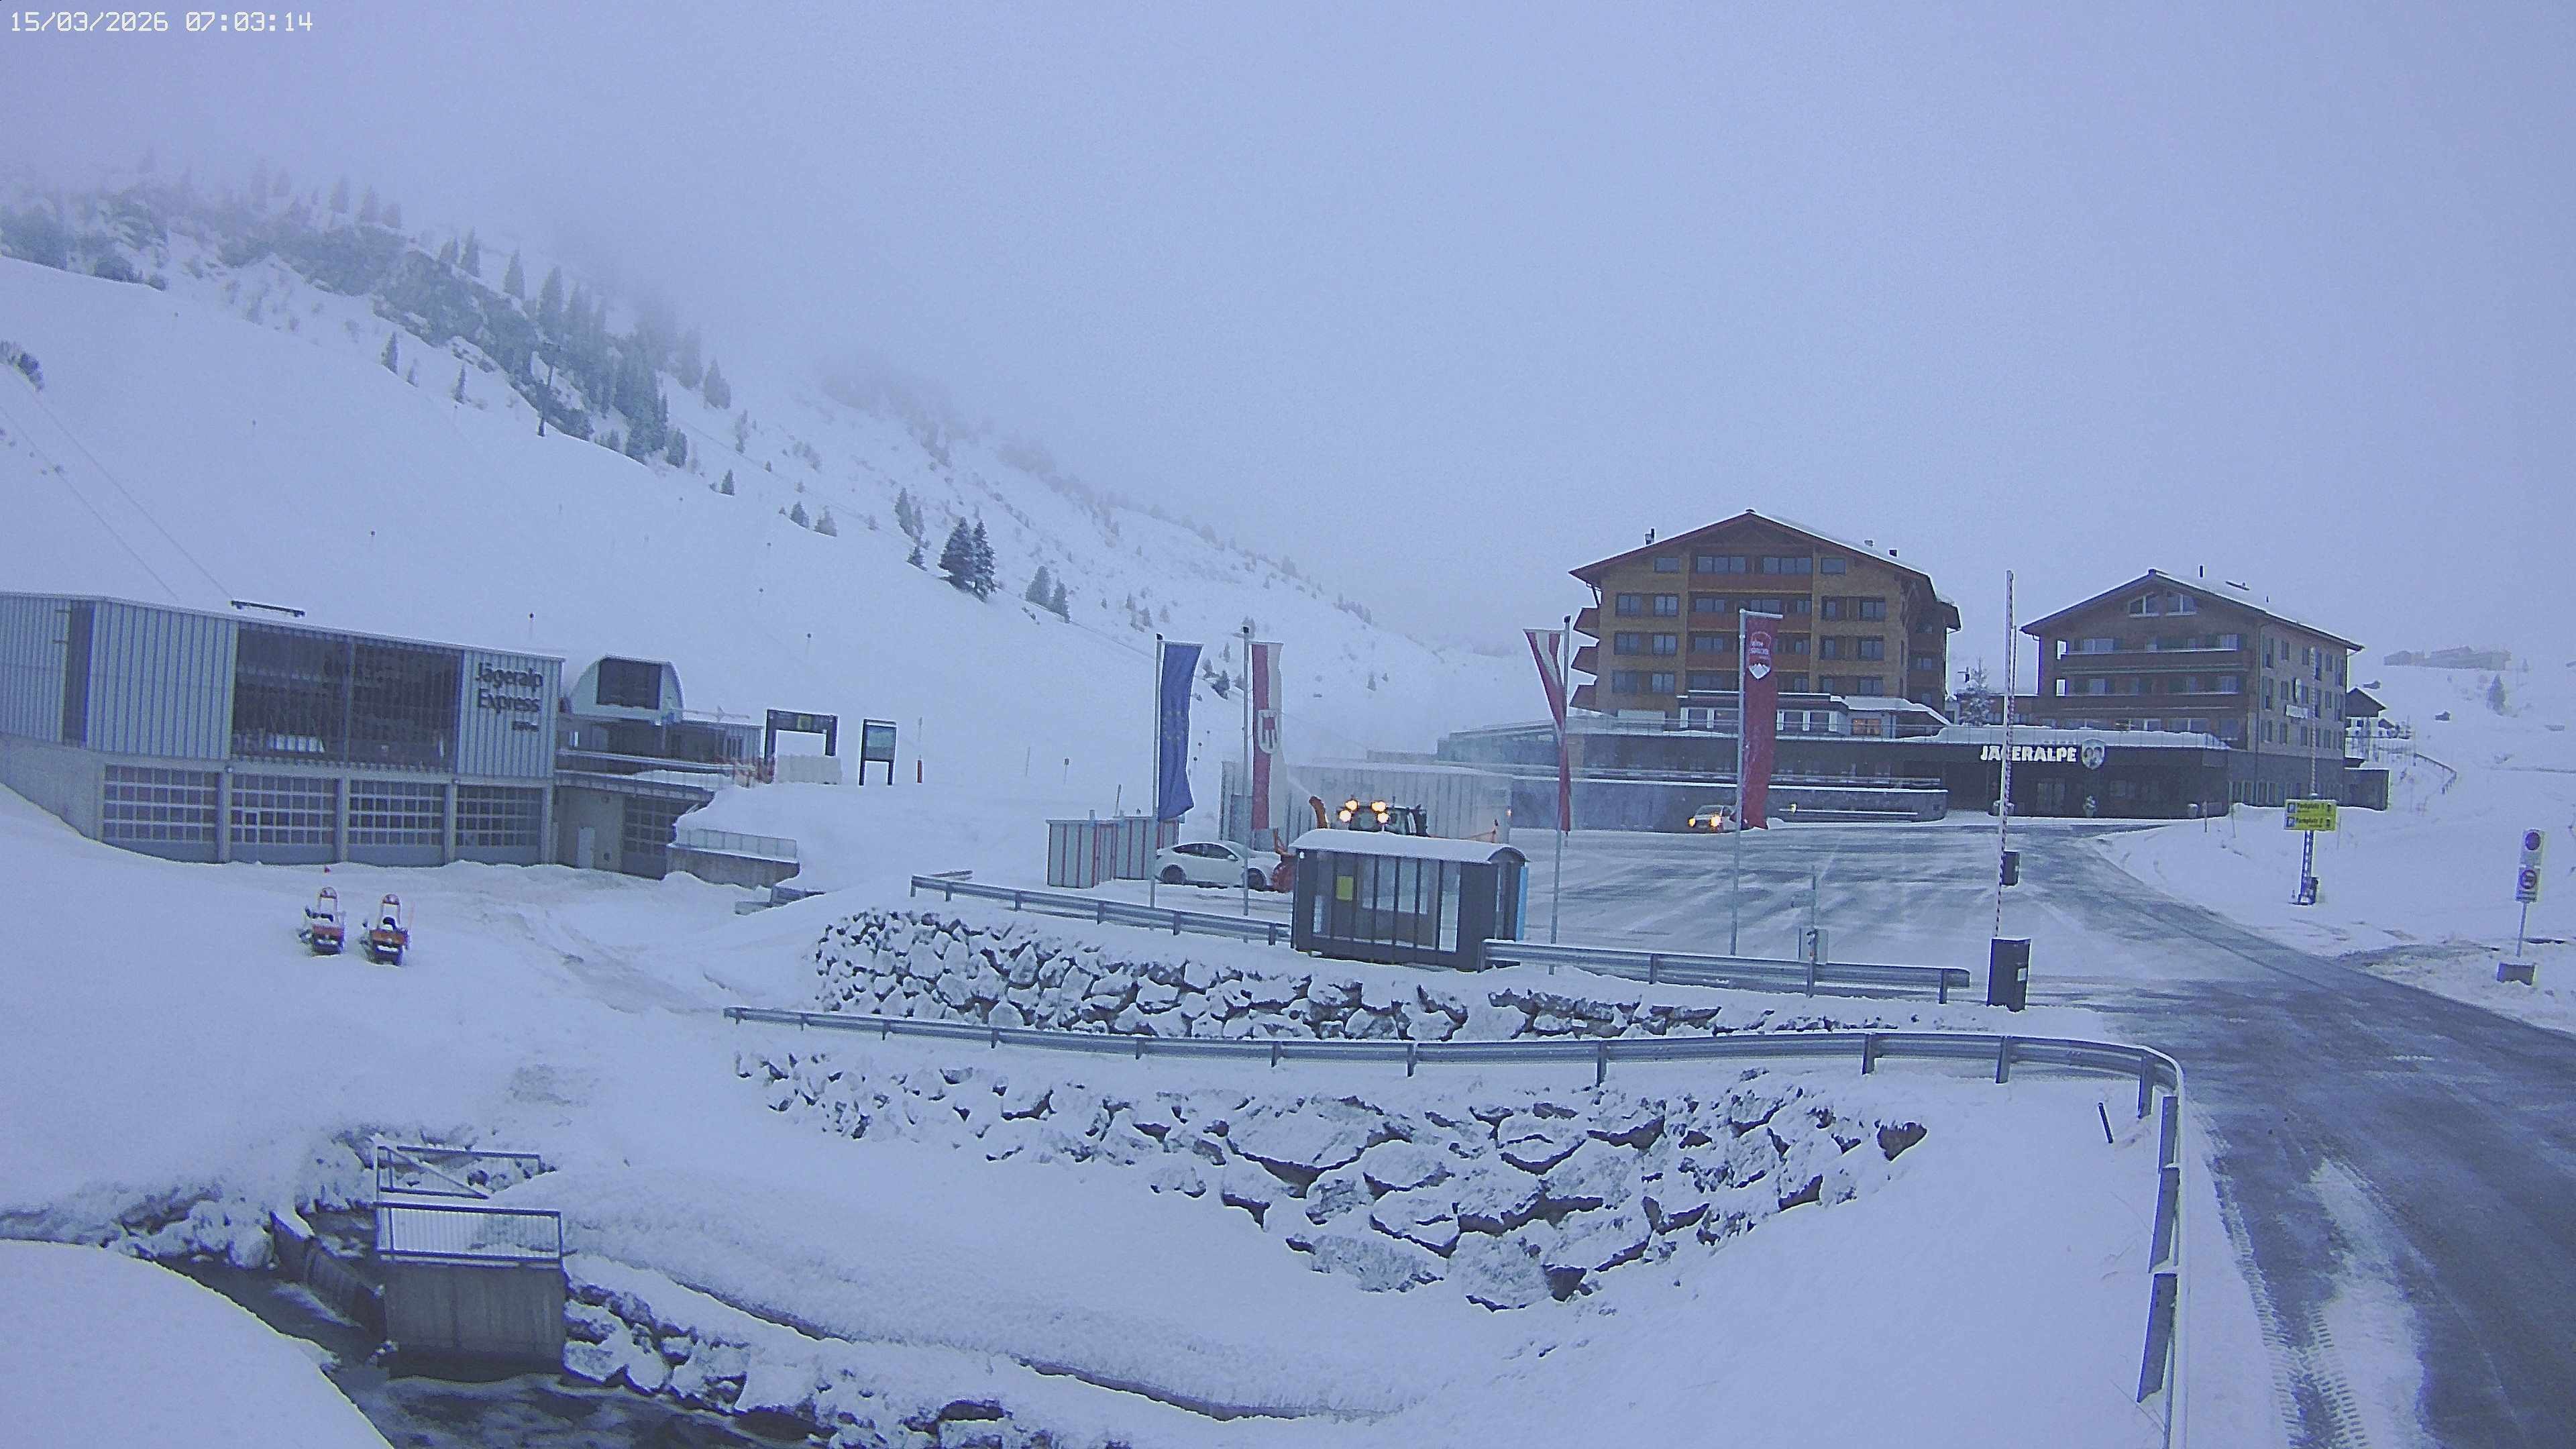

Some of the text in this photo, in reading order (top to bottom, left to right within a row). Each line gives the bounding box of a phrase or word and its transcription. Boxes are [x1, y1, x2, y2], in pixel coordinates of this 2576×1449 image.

[476, 662, 543, 692] Jägeralp
[478, 688, 540, 713] Express
[1980, 745, 2077, 762] JÄERALPE
